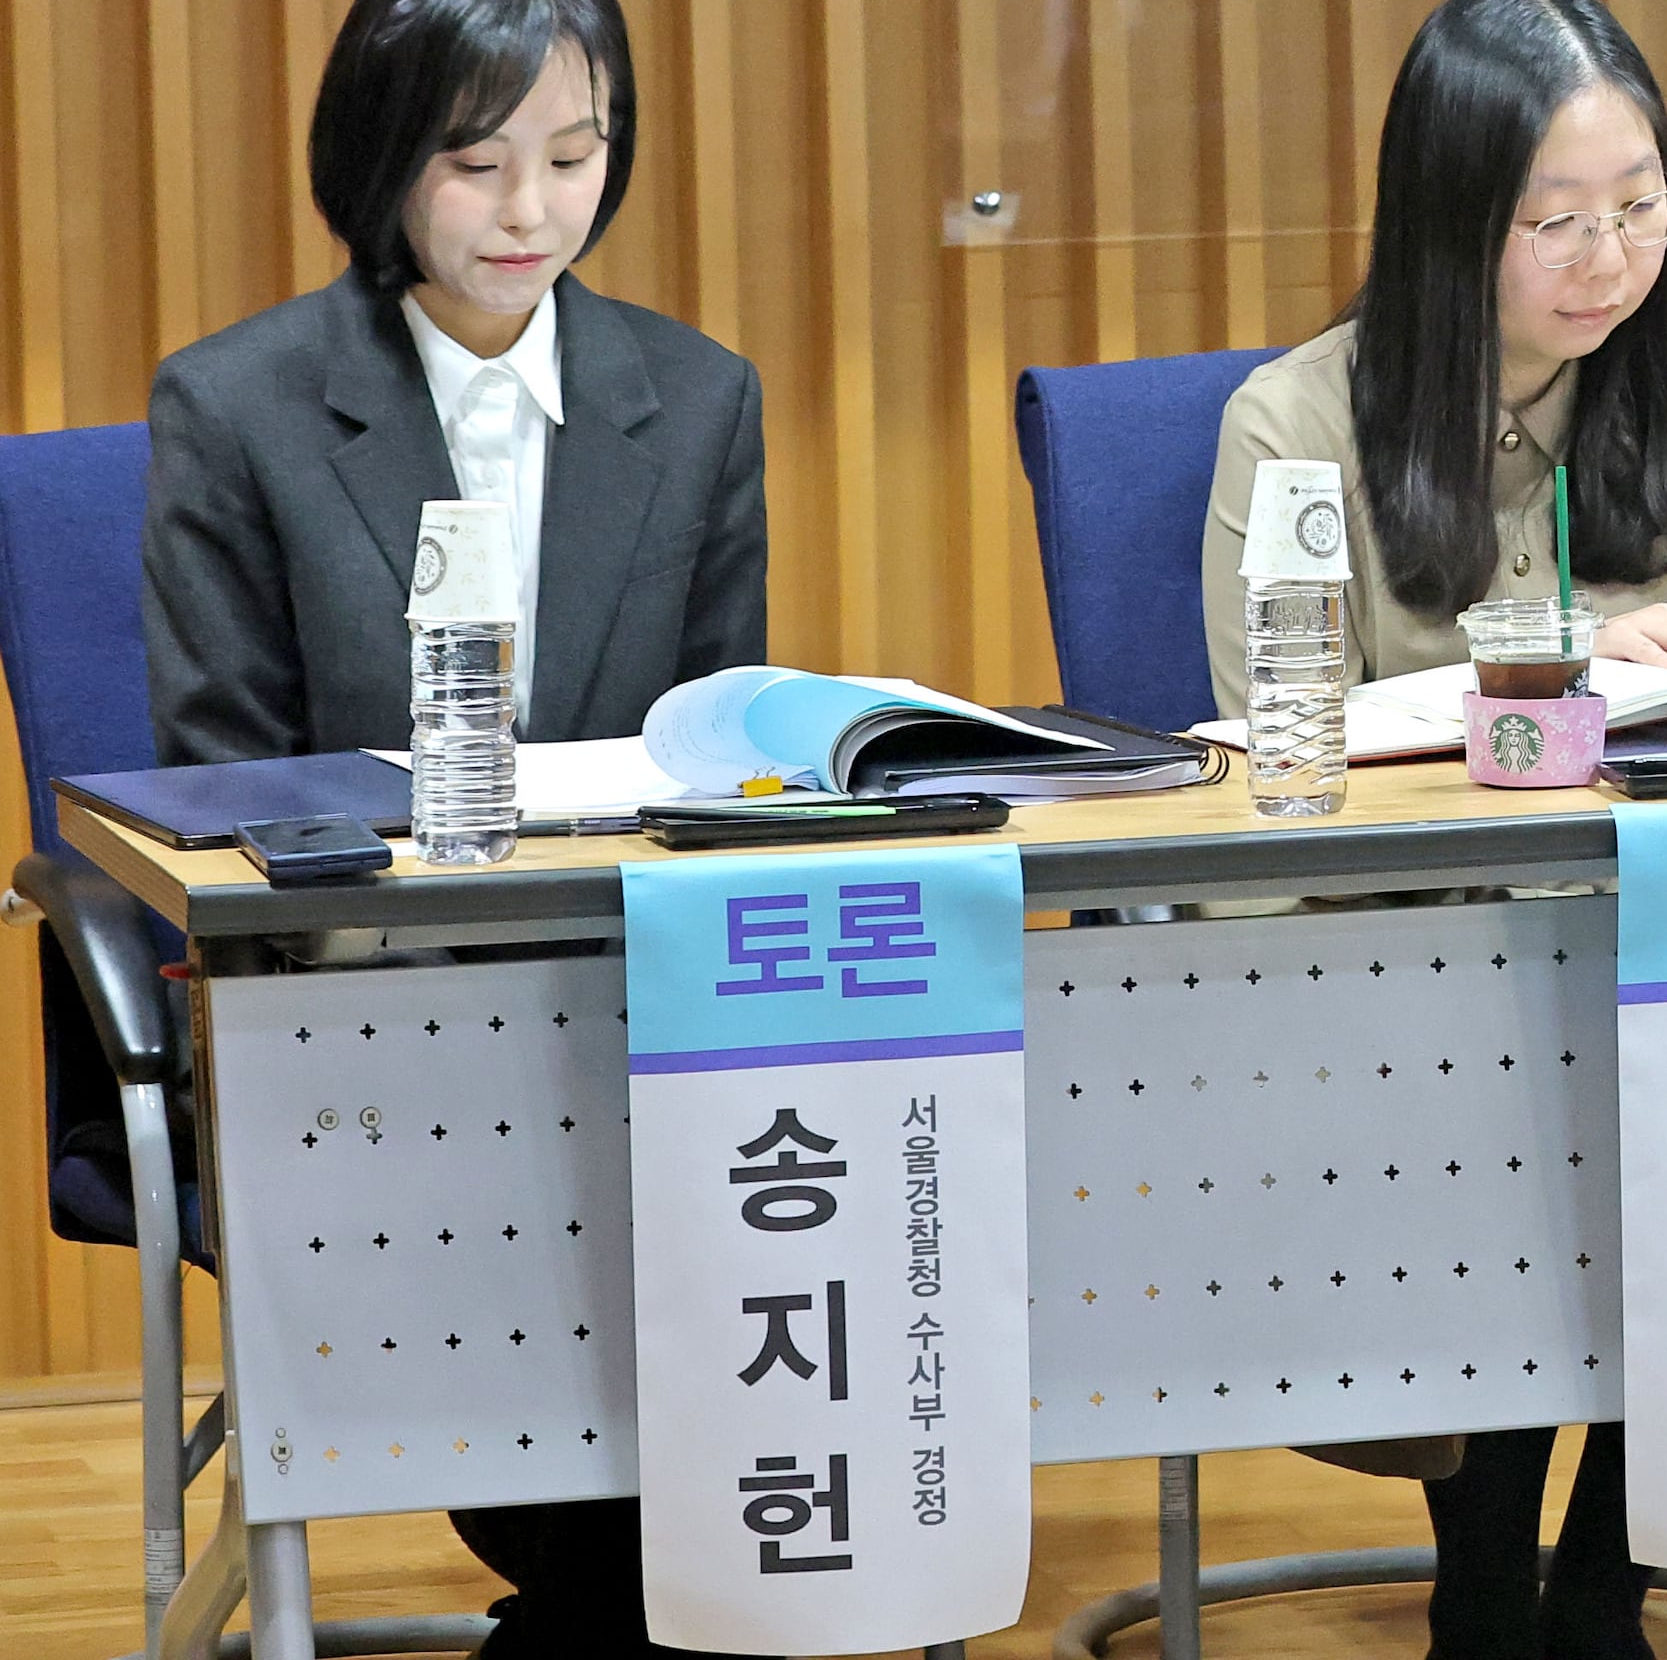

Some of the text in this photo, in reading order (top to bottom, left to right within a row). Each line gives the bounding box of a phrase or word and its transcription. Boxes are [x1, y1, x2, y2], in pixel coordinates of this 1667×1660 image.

[716, 882, 936, 998] 토론
[730, 1109, 852, 1574] 송지헌
[902, 1095, 946, 1525] 서울경찰청 수사부 경정
